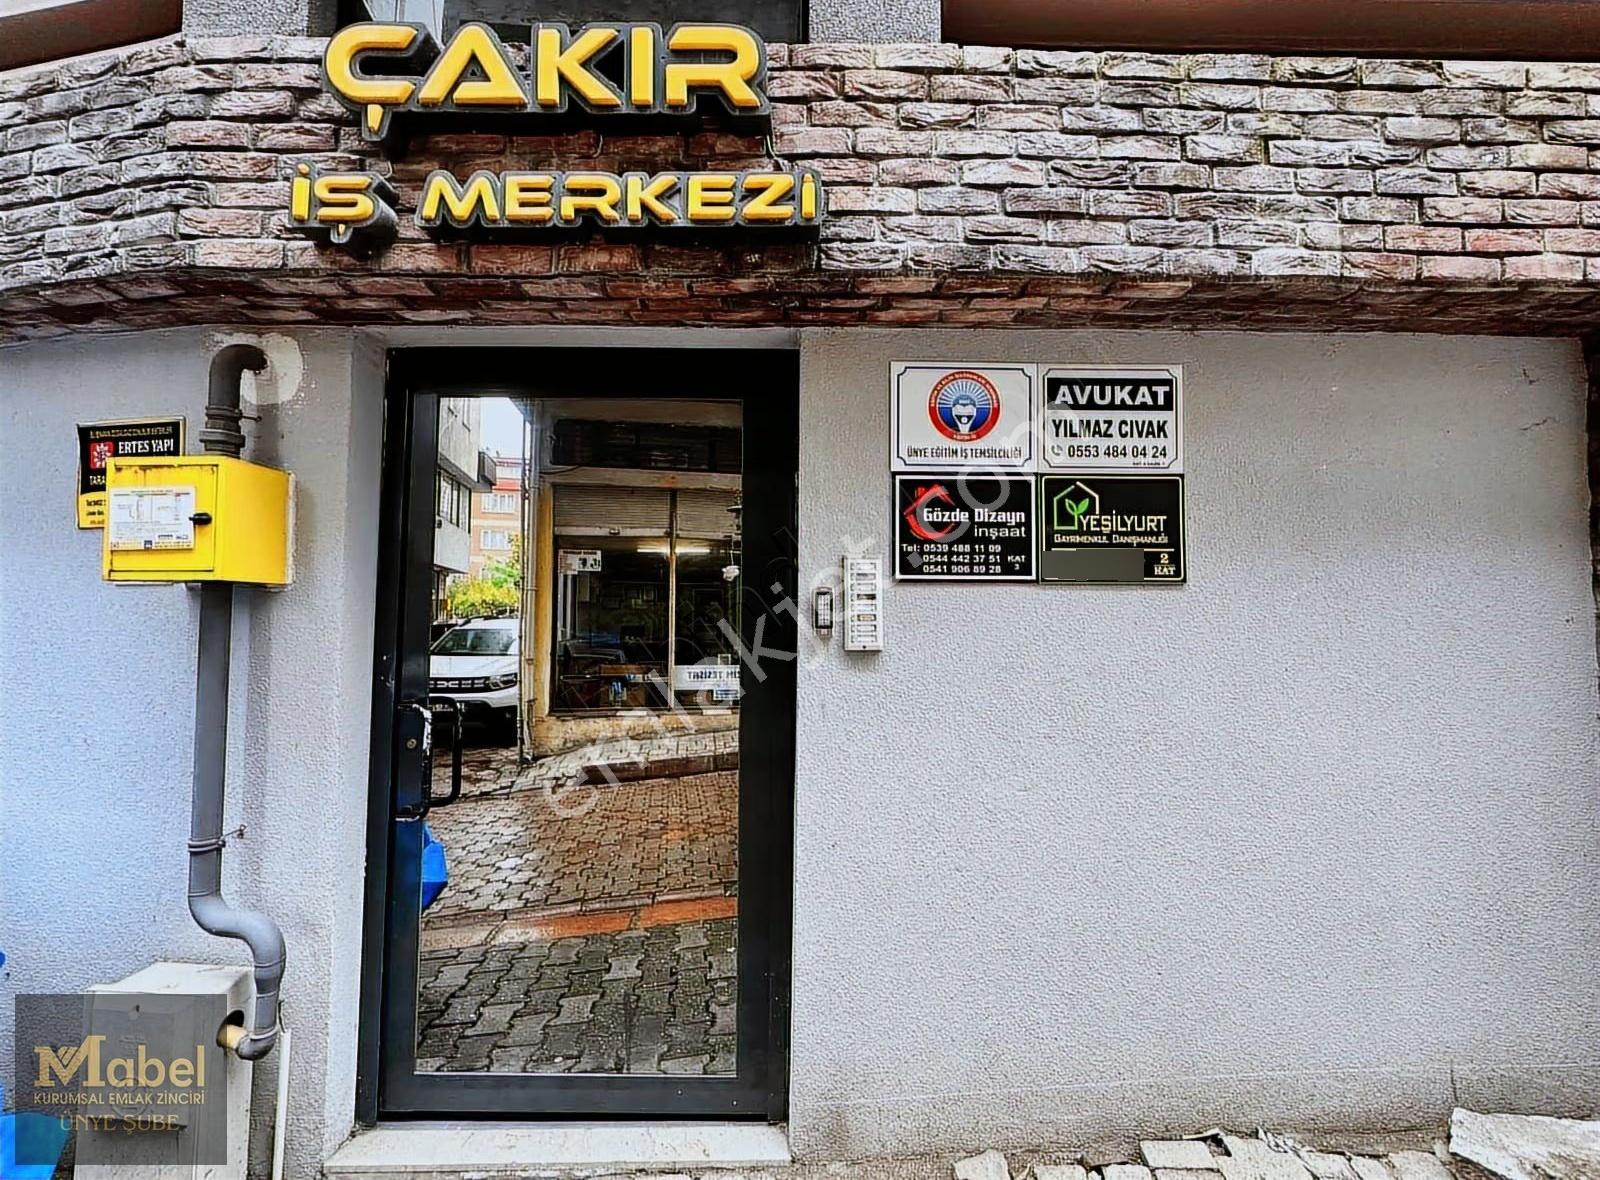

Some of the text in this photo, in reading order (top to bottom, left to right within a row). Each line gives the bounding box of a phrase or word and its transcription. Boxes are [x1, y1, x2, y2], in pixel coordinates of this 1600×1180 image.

[325, 24, 762, 133] ÇAKIR
[291, 163, 816, 237] İŞ MERKEZİ
[1055, 385, 1170, 406] AVUKAT
[1052, 419, 1169, 438] YILMAZ CIVAK
[151, 438, 174, 452] YAPI
[907, 445, 1022, 459] ÜNYE EĞİTİM İŞ TEMSİLCİLİĞİ
[1068, 445, 1168, 458] 0553 484 04 24
[923, 508, 1026, 526] Gözde Dizayn
[1079, 509, 1167, 533] YEŞİLYURT
[974, 525, 1026, 540] inşaat
[901, 543, 921, 552] Tel:
[974, 544, 985, 553] 11
[922, 554, 1001, 563] 0544 442 37 51
[1160, 553, 1169, 564] 2
[922, 565, 948, 574] 0541
[1154, 566, 1176, 576] KAT
